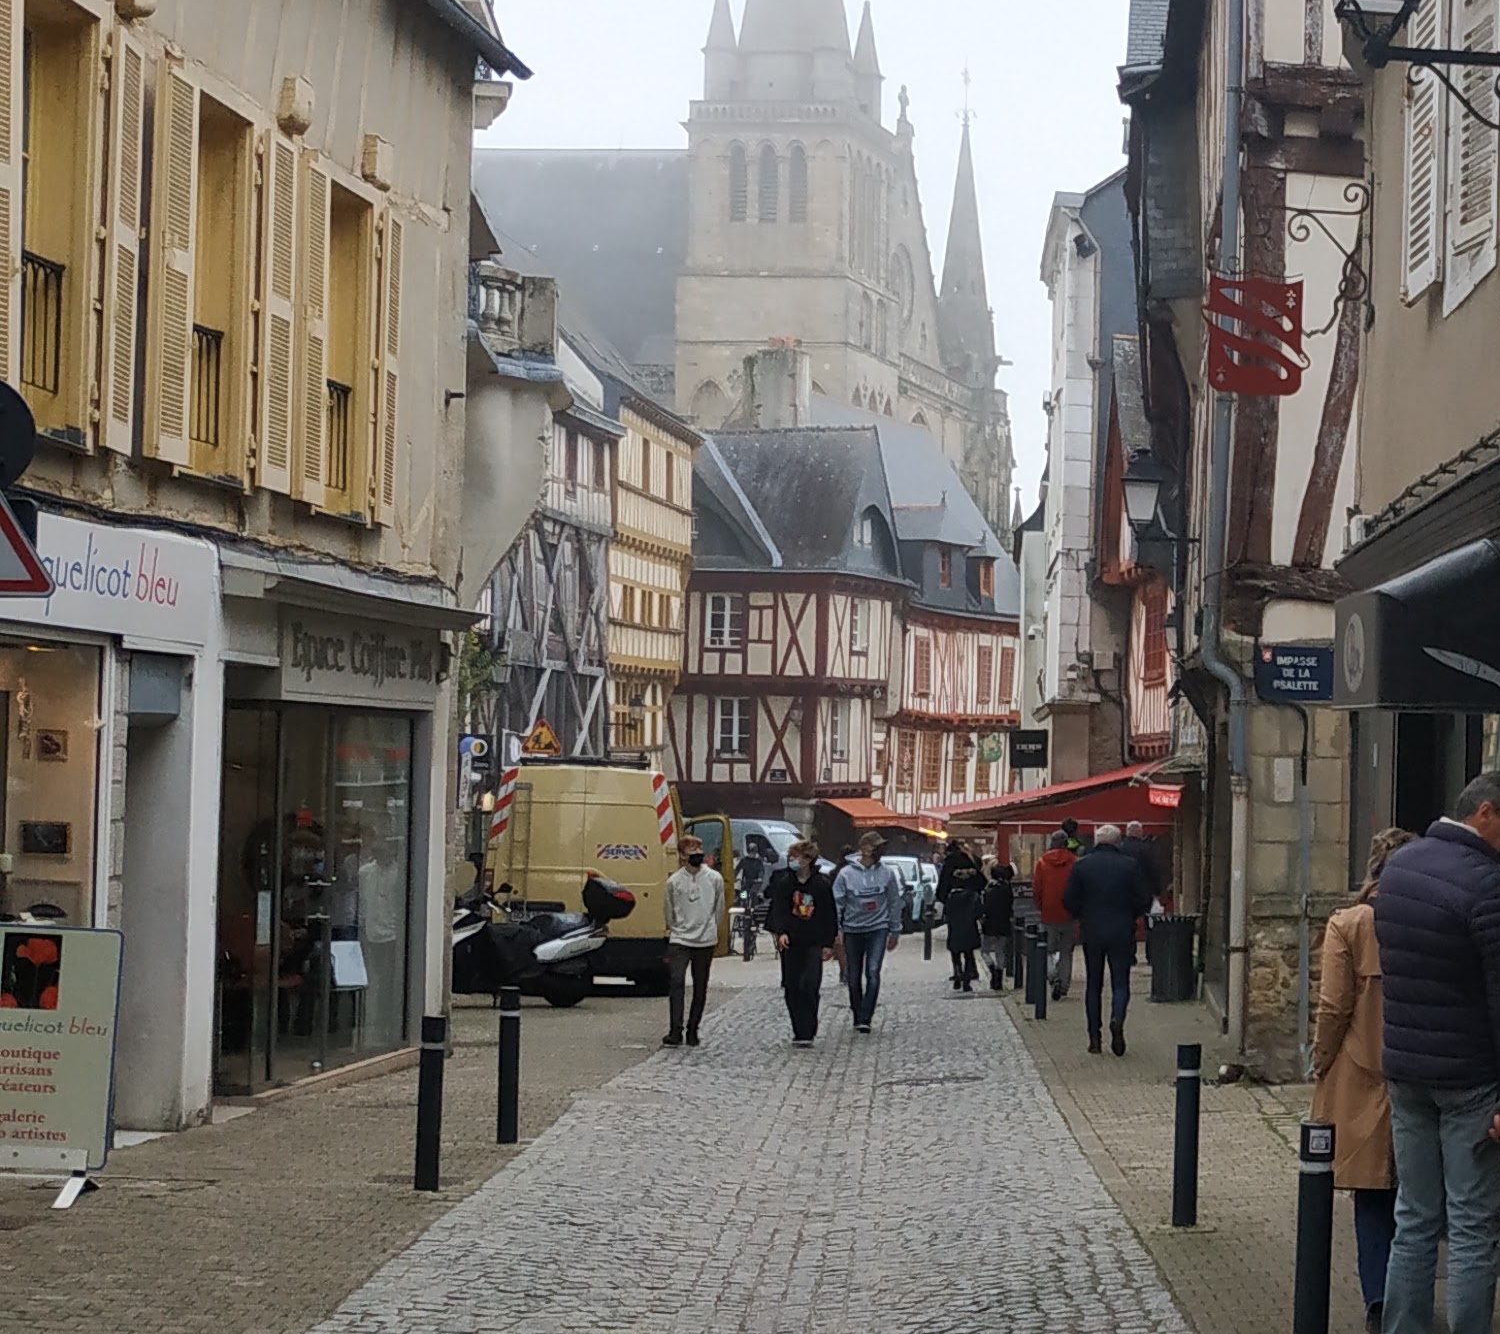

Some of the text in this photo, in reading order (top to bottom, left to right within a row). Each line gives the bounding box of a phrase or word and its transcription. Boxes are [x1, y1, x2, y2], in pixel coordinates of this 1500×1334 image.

[135, 542, 179, 607] bleu
[1276, 656, 1318, 667] IMPASSE
[1282, 668, 1311, 678] DE LA
[1272, 679, 1319, 690] PSALETTE
[605, 848, 639, 856] SERVICE
[0, 1015, 108, 1036] uelicot bleu
[0, 1062, 53, 1076] rtisans
[11, 1127, 67, 1141] artistes
